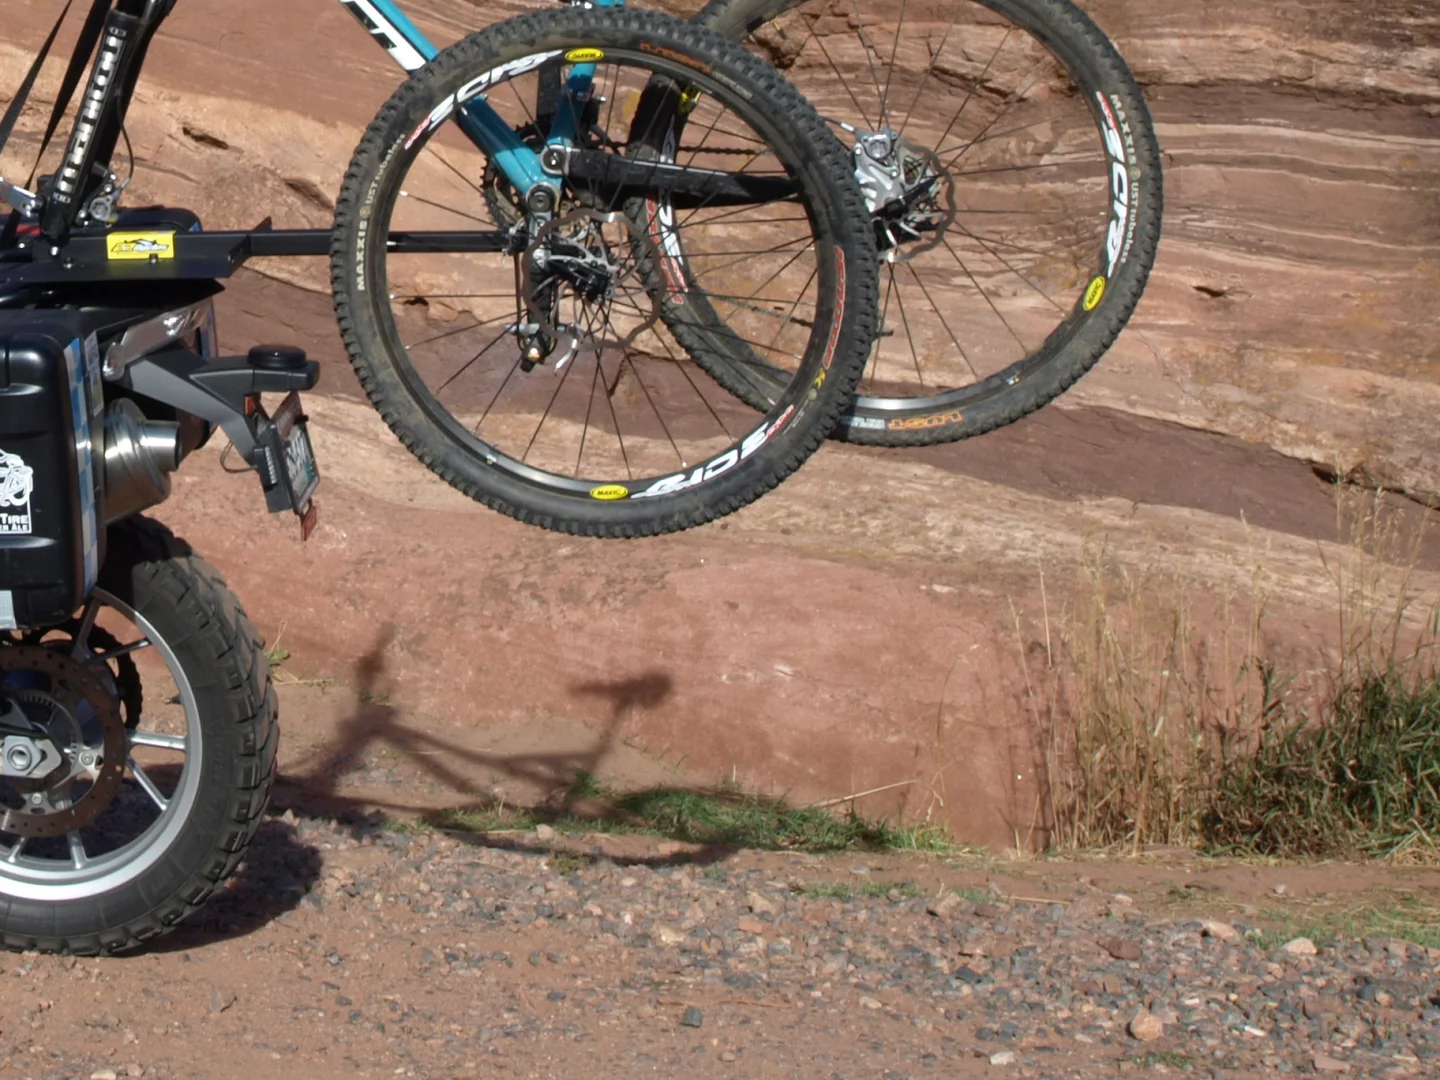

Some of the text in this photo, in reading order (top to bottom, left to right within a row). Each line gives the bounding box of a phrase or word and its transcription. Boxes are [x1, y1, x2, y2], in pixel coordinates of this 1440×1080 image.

[356, 133, 406, 290] MAXXIS UST tubeless
[1110, 93, 1139, 264] MAXXIS UST tubeless
